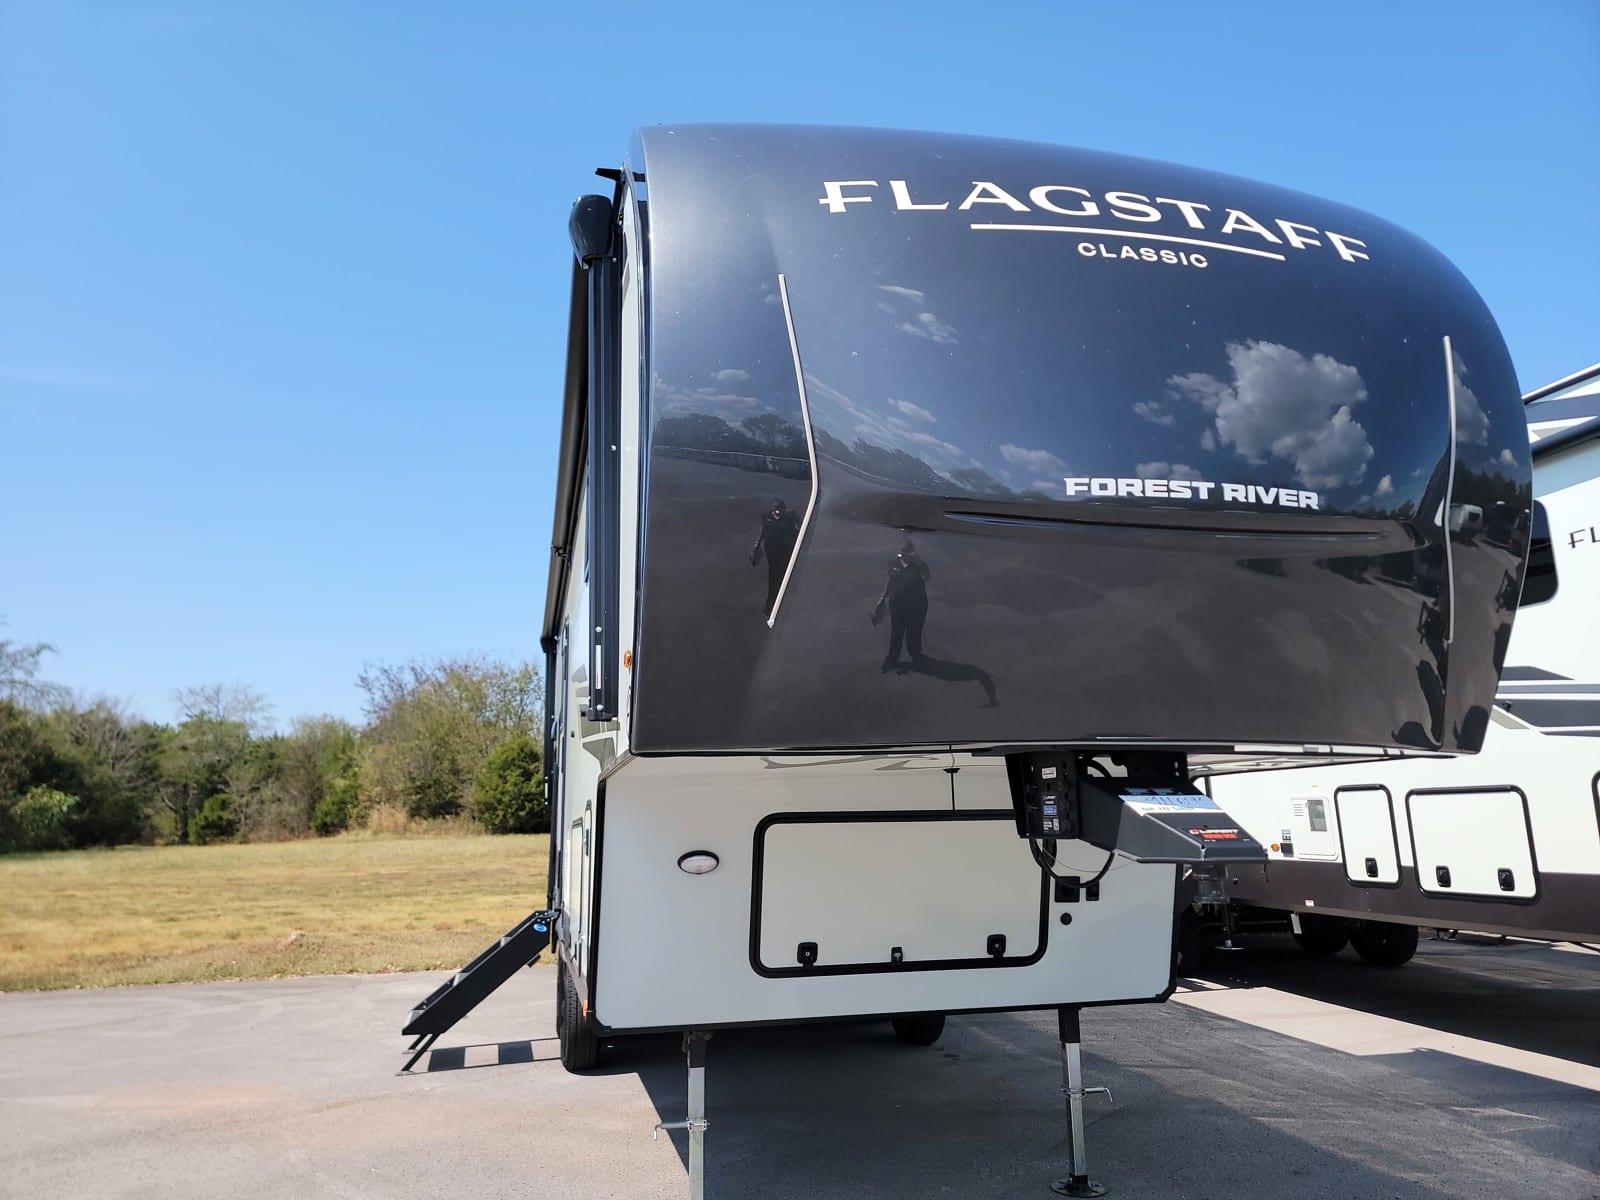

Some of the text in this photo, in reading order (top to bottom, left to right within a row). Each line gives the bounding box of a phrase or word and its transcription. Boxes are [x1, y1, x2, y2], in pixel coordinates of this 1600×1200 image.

[818, 180, 1370, 263] FLAGSTAFF
[1077, 242, 1208, 268] CLASSIC
[1063, 477, 1320, 510] FOREST RIVER
